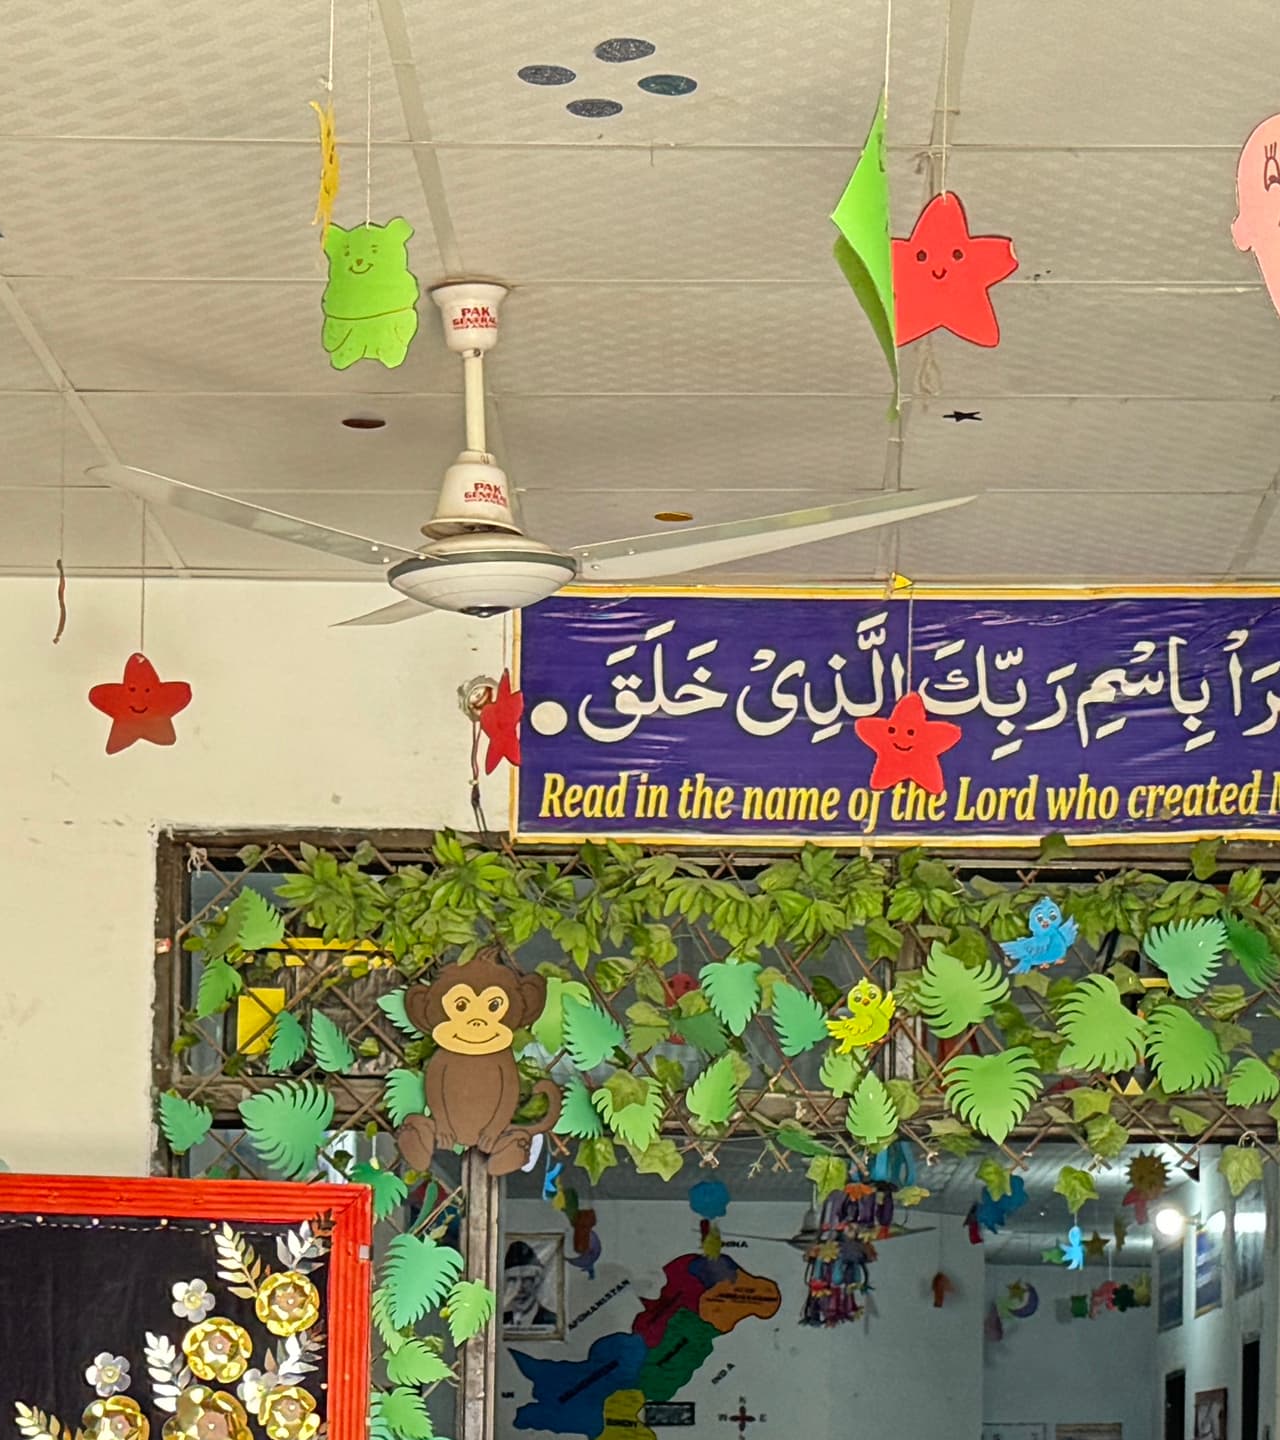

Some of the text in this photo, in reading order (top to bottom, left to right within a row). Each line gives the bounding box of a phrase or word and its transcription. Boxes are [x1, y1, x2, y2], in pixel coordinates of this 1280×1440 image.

[461, 306, 490, 317] PAK
[474, 483, 502, 494] PAK
[538, 772, 629, 819] Read
[634, 772, 668, 819] in
[679, 773, 732, 820] the
[742, 784, 840, 821] name
[891, 781, 948, 822] the
[954, 774, 1039, 822] Lord
[1047, 774, 1119, 821] who
[1128, 770, 1264, 819] created
